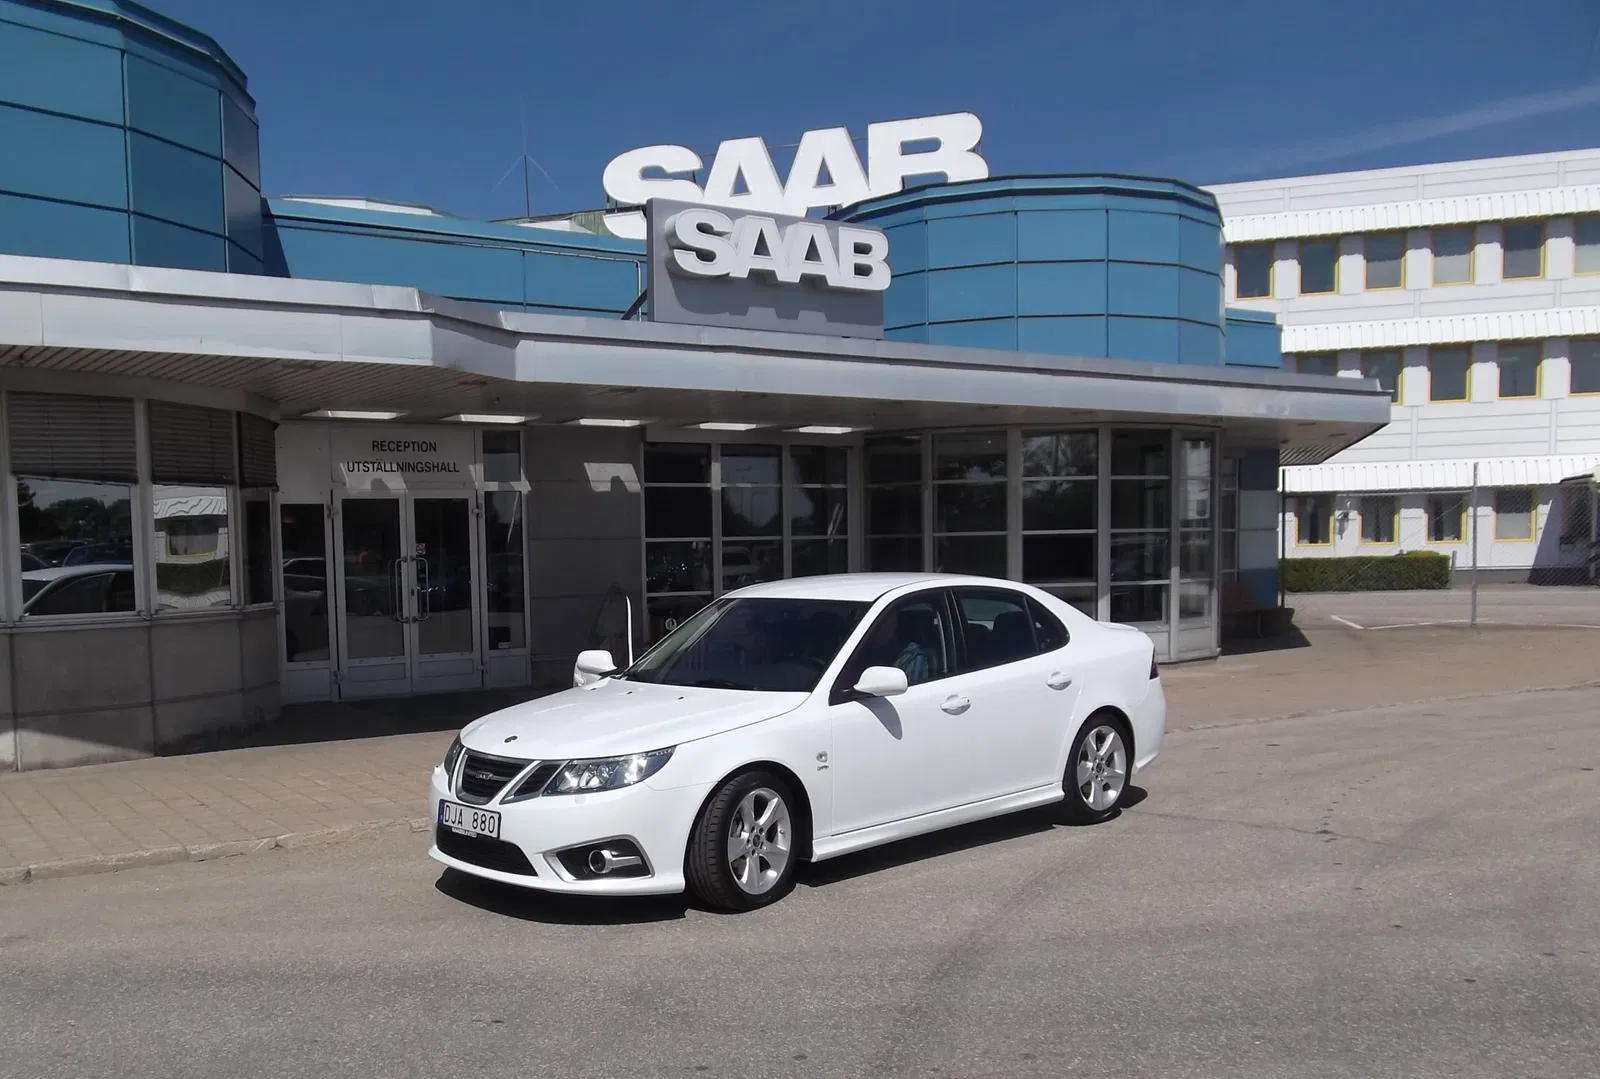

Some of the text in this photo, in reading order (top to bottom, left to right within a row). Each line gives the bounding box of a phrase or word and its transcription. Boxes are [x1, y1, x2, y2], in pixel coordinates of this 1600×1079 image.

[602, 111, 989, 239] SAAB
[666, 208, 892, 291] SAAB
[371, 440, 437, 453] RECEPTION
[346, 458, 460, 473] UTSTÄLLNINGSHALL
[444, 804, 463, 827] DJA
[472, 811, 496, 834] 880
